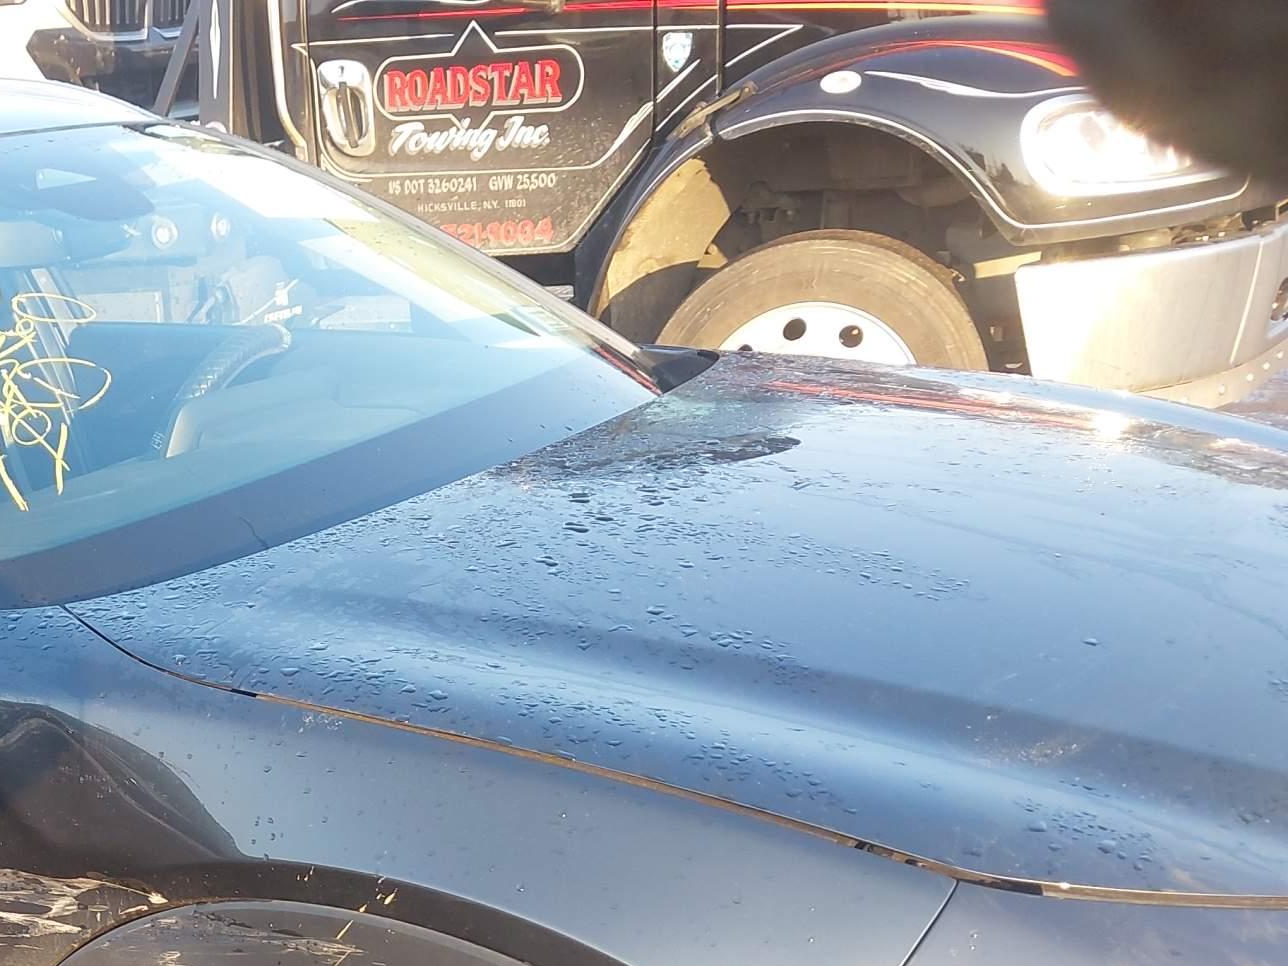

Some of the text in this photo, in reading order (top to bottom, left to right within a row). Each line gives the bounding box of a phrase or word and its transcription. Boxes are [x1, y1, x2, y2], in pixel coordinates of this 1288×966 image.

[384, 60, 562, 112] ROADSTAR
[389, 116, 550, 161] Towing Inc.
[389, 172, 556, 195] US DOT 3260241 GVW 25,500
